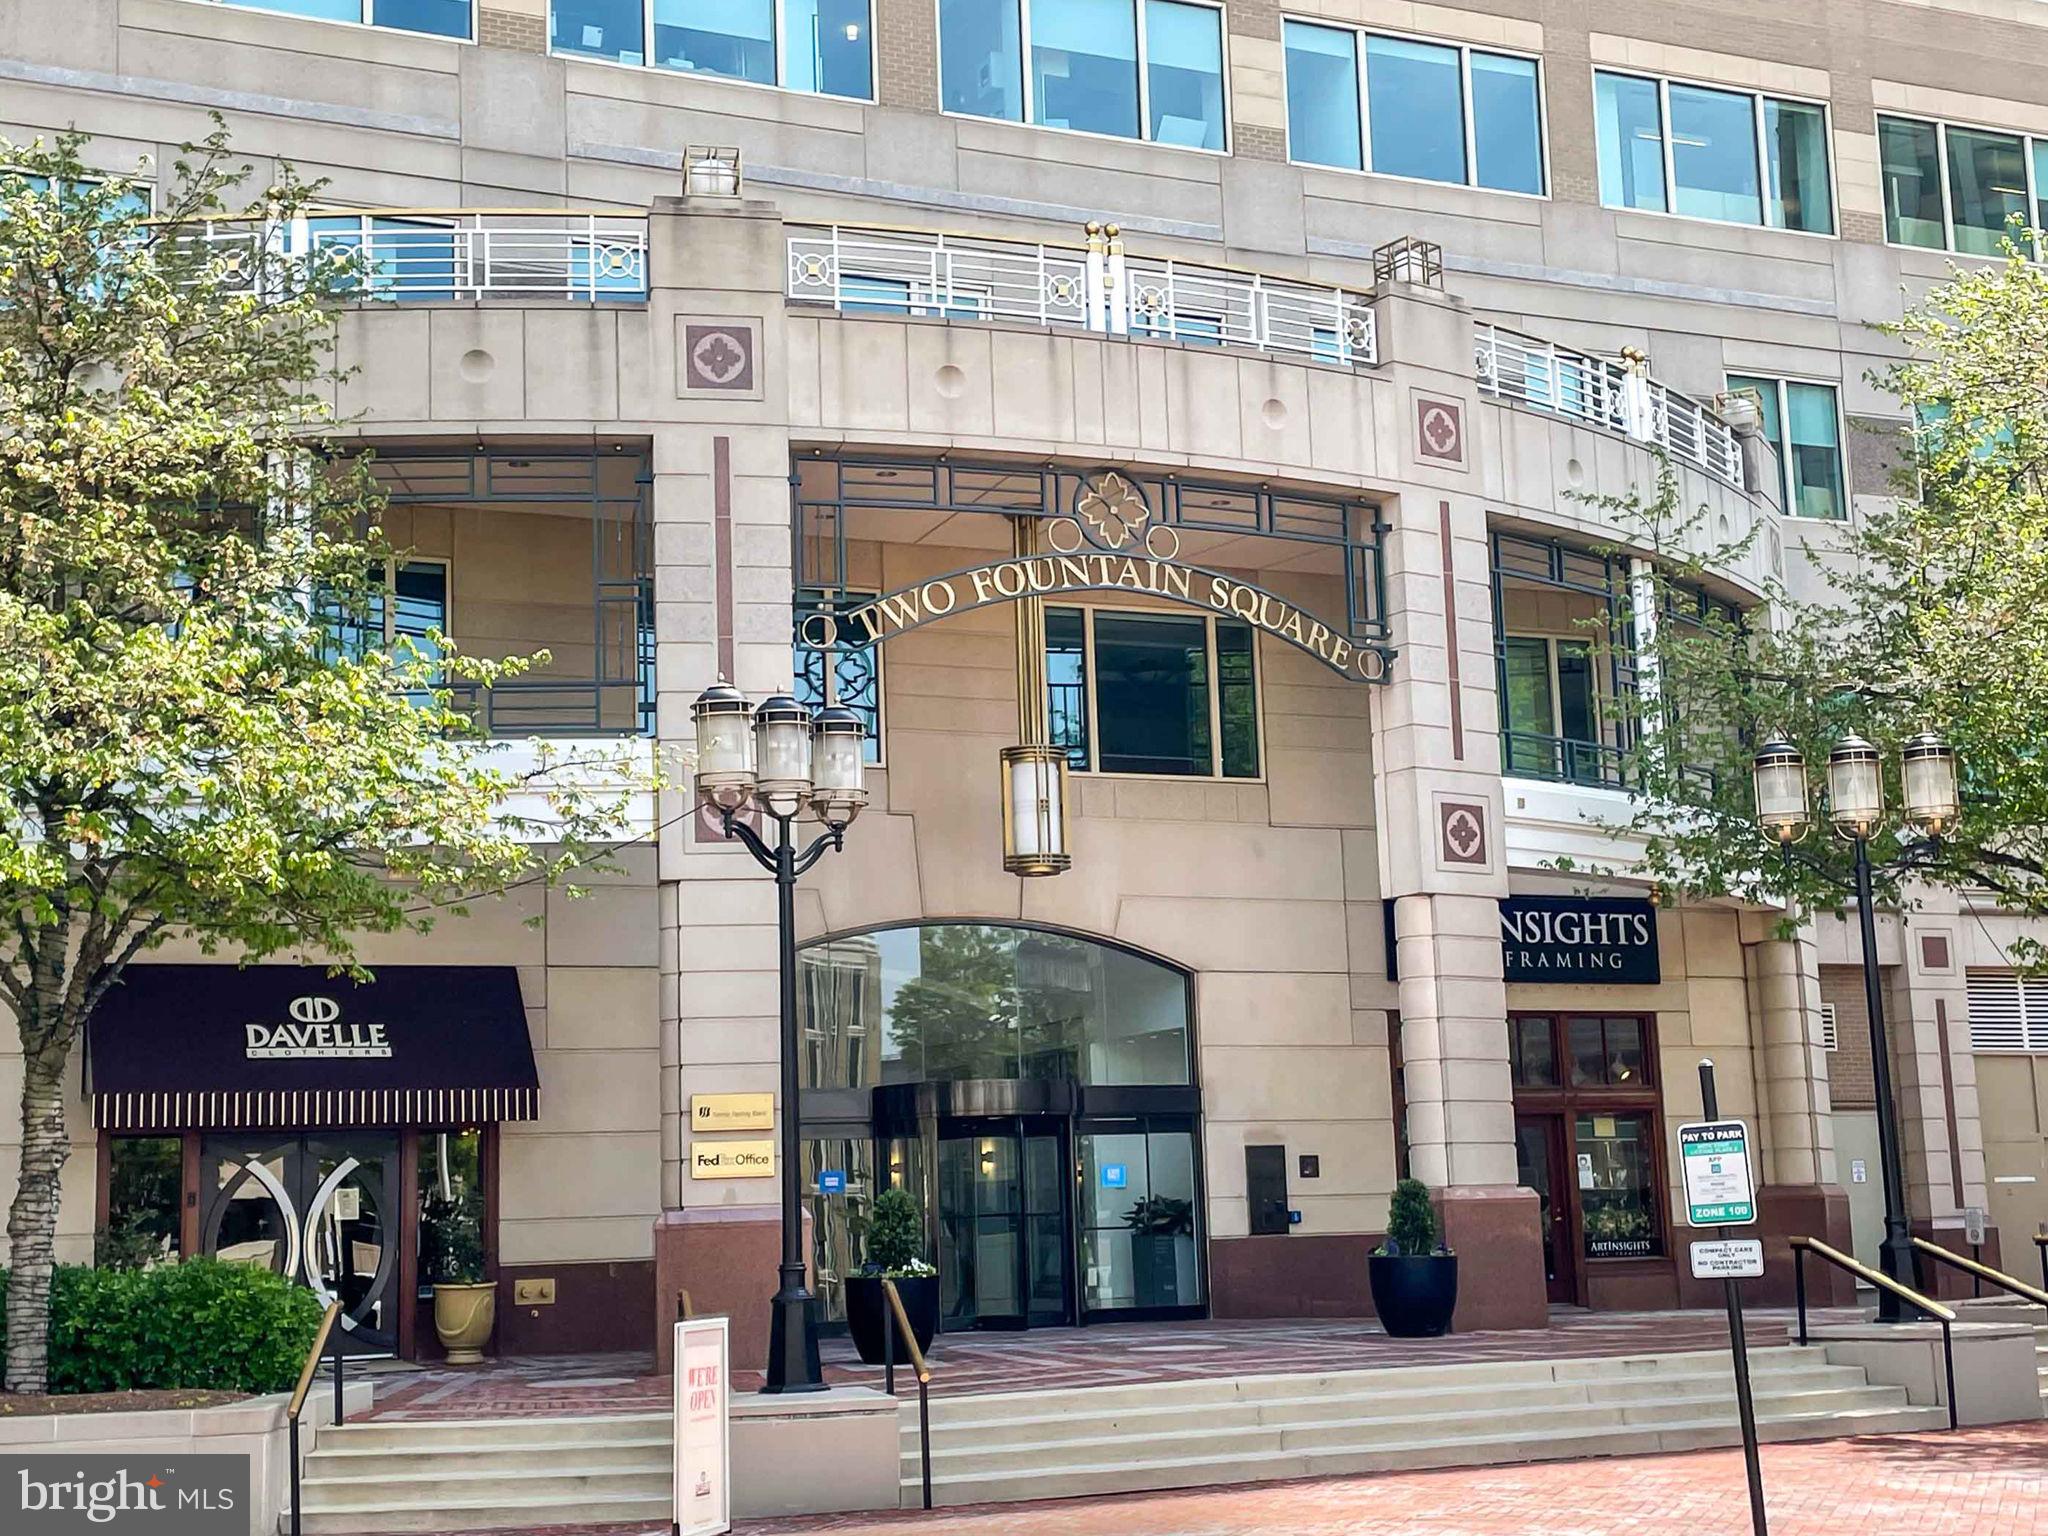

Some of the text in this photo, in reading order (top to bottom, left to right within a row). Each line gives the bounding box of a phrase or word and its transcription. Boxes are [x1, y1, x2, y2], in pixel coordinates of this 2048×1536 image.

[848, 554, 1353, 670] TWO FOUNTAIN SQUARE
[1505, 951, 1623, 969] FRAMING
[245, 1023, 390, 1048] DAVELLE
[251, 1049, 388, 1057] CLOTHIERS
[1682, 1130, 1743, 1142] PAY TO PARK
[697, 1153, 769, 1167] Fed Office
[1695, 1205, 1748, 1217] ZONE 100
[690, 1389, 715, 1411] OPEN
